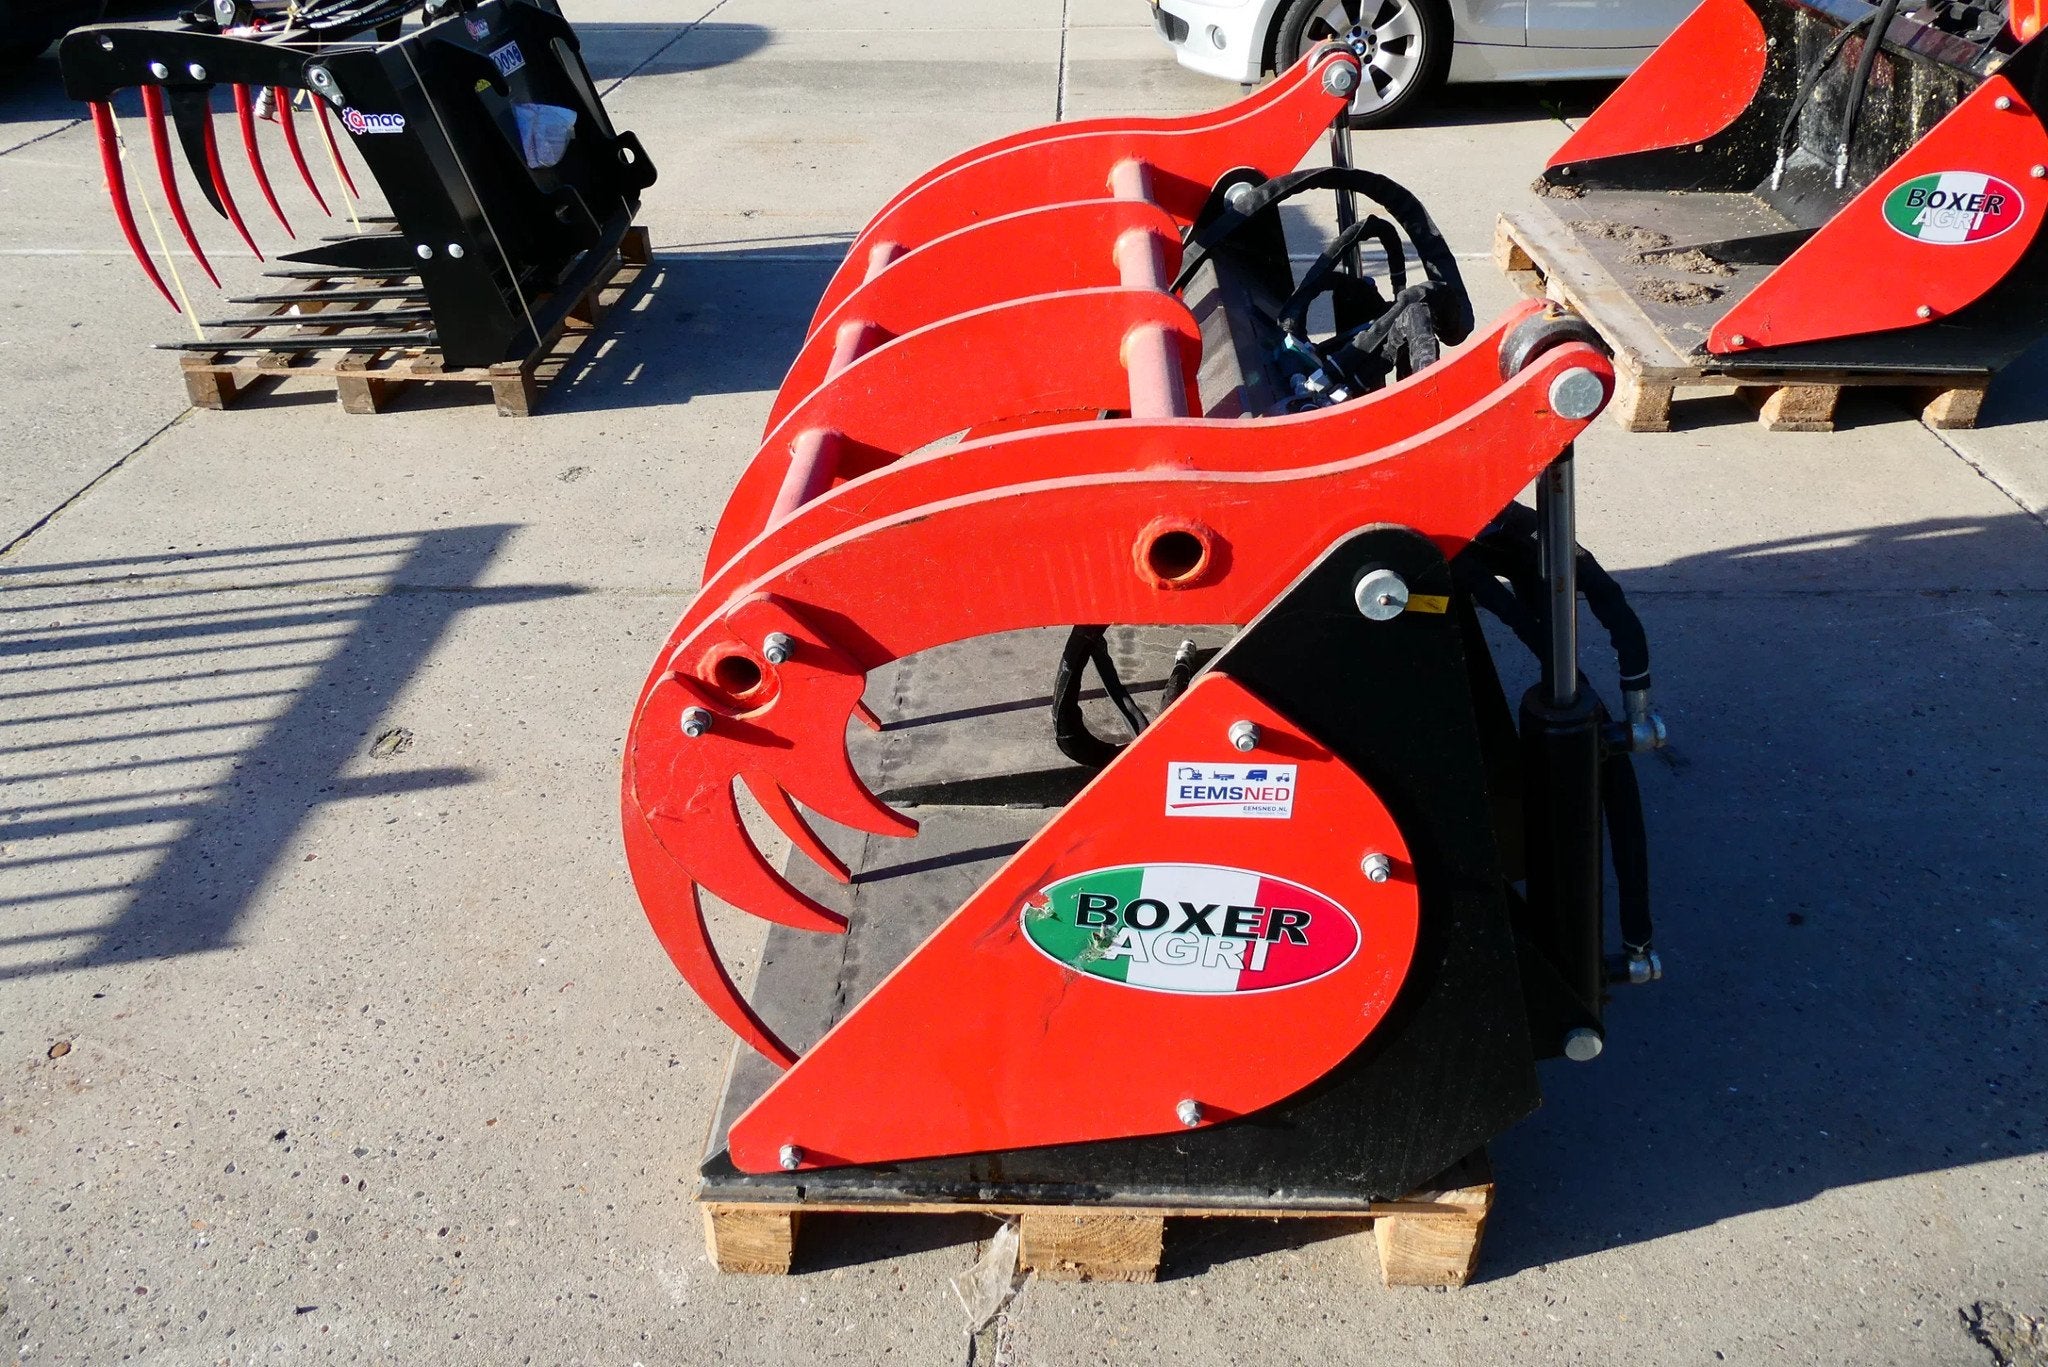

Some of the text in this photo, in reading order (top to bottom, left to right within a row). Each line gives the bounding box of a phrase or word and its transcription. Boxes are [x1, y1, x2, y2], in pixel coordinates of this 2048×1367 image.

[1906, 187, 2005, 215] BOXER
[1911, 206, 1985, 231] AGRI
[1180, 785, 1290, 801] EEMSNED
[1074, 893, 1312, 946] BOXER
[1100, 926, 1271, 972] AGRI
